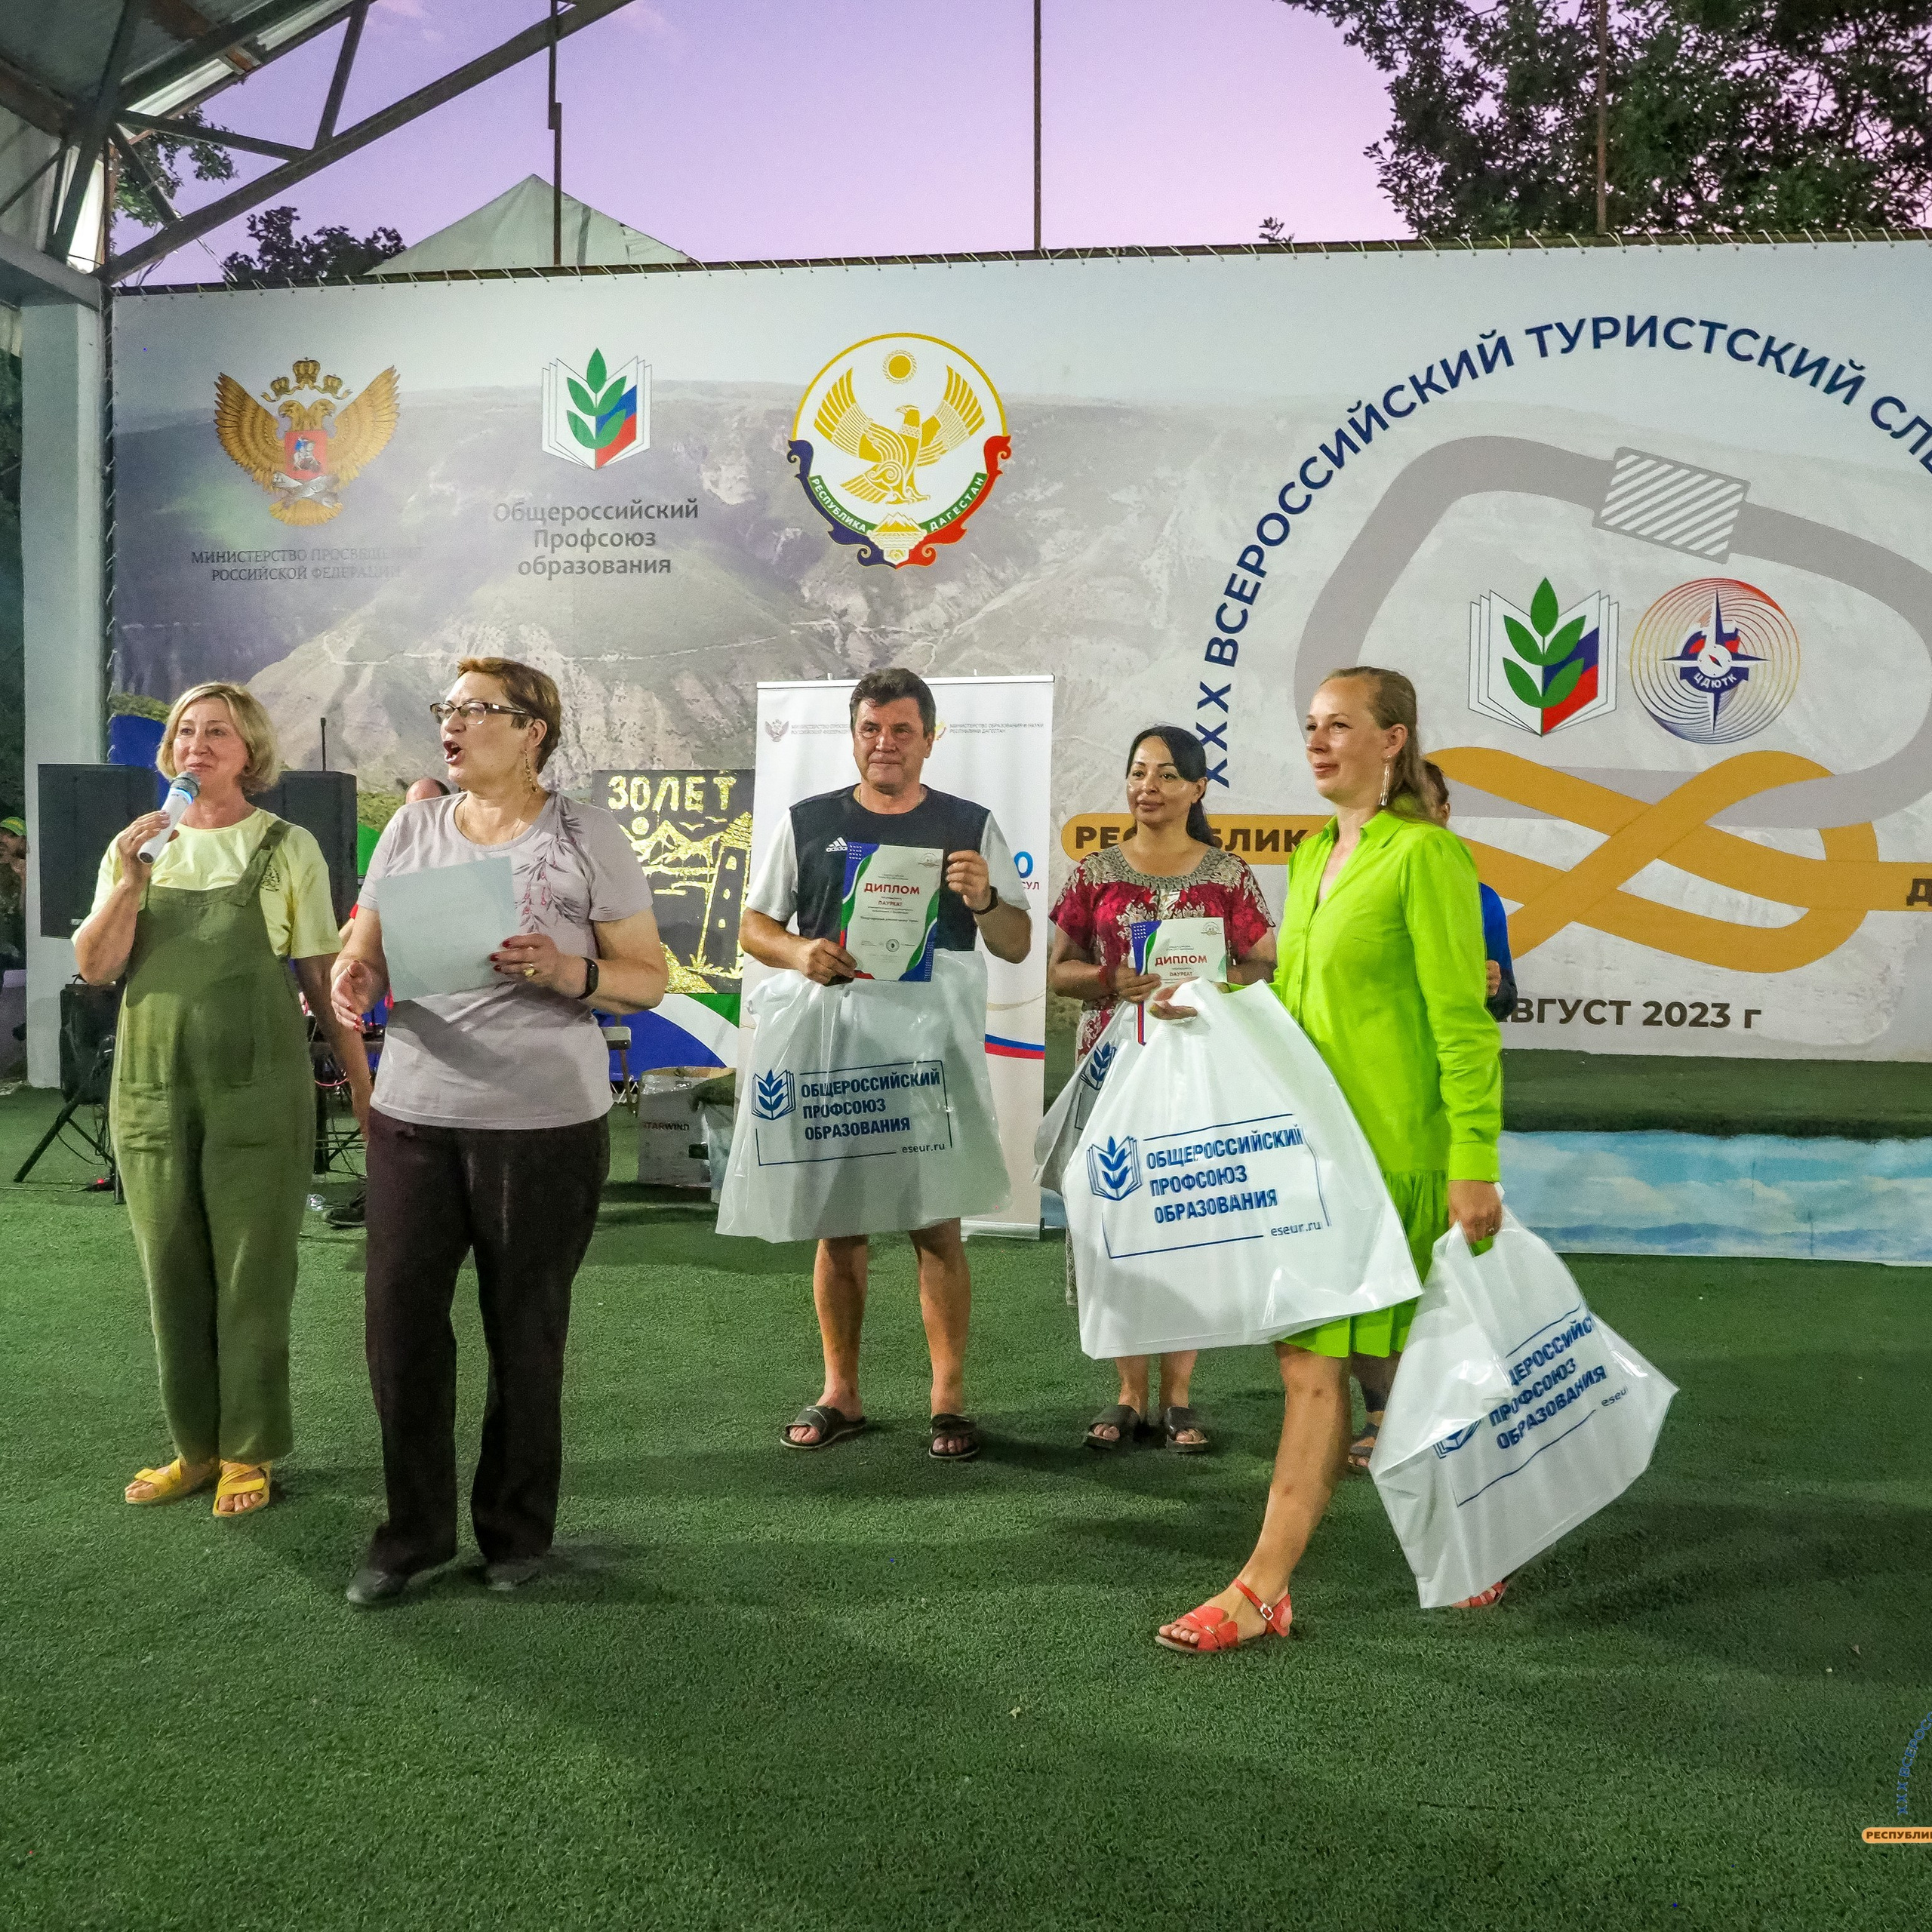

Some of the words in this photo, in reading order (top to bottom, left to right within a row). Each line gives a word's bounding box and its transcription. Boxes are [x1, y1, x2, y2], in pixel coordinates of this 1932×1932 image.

[1204, 329, 1515, 667] ВСЕРОССИЙСКИЙ
[1524, 315, 1866, 406] ТУРИСТСКИЙ
[494, 498, 699, 527] Общероссийский
[811, 478, 866, 532] РЕСПУБЛИКА
[929, 477, 985, 532] ДАГЕСТАН
[534, 528, 657, 554] Профсоюз
[191, 549, 307, 564] МИНИСТЕРСТВО
[518, 555, 672, 581] образования
[212, 566, 307, 581] РОССИЙСКОЙ
[1693, 672, 1737, 688] ЦДЮТК
[864, 883, 920, 895] ДИПЛОМ
[1155, 955, 1208, 967] ДИПЛОМ
[1499, 998, 1632, 1026] ВГУСТ
[1642, 1000, 1731, 1029] 2023
[1744, 1008, 1762, 1029] г
[801, 1068, 941, 1098] ОБЩЕРОССИЙСКИЙ
[803, 1098, 887, 1119] ПРОФСОЮЗ
[804, 1117, 911, 1140] ОБРАЗОВАНИЯ
[902, 1143, 946, 1154] eseur.ru
[1149, 1164, 1248, 1197] ПРОФСОЮЗ
[1154, 1189, 1278, 1224] ОБРАЗОВАНИЯ
[1271, 1220, 1321, 1236] eseur.ru
[1496, 1365, 1607, 1450] ОБРАЗОВАНИЯ
